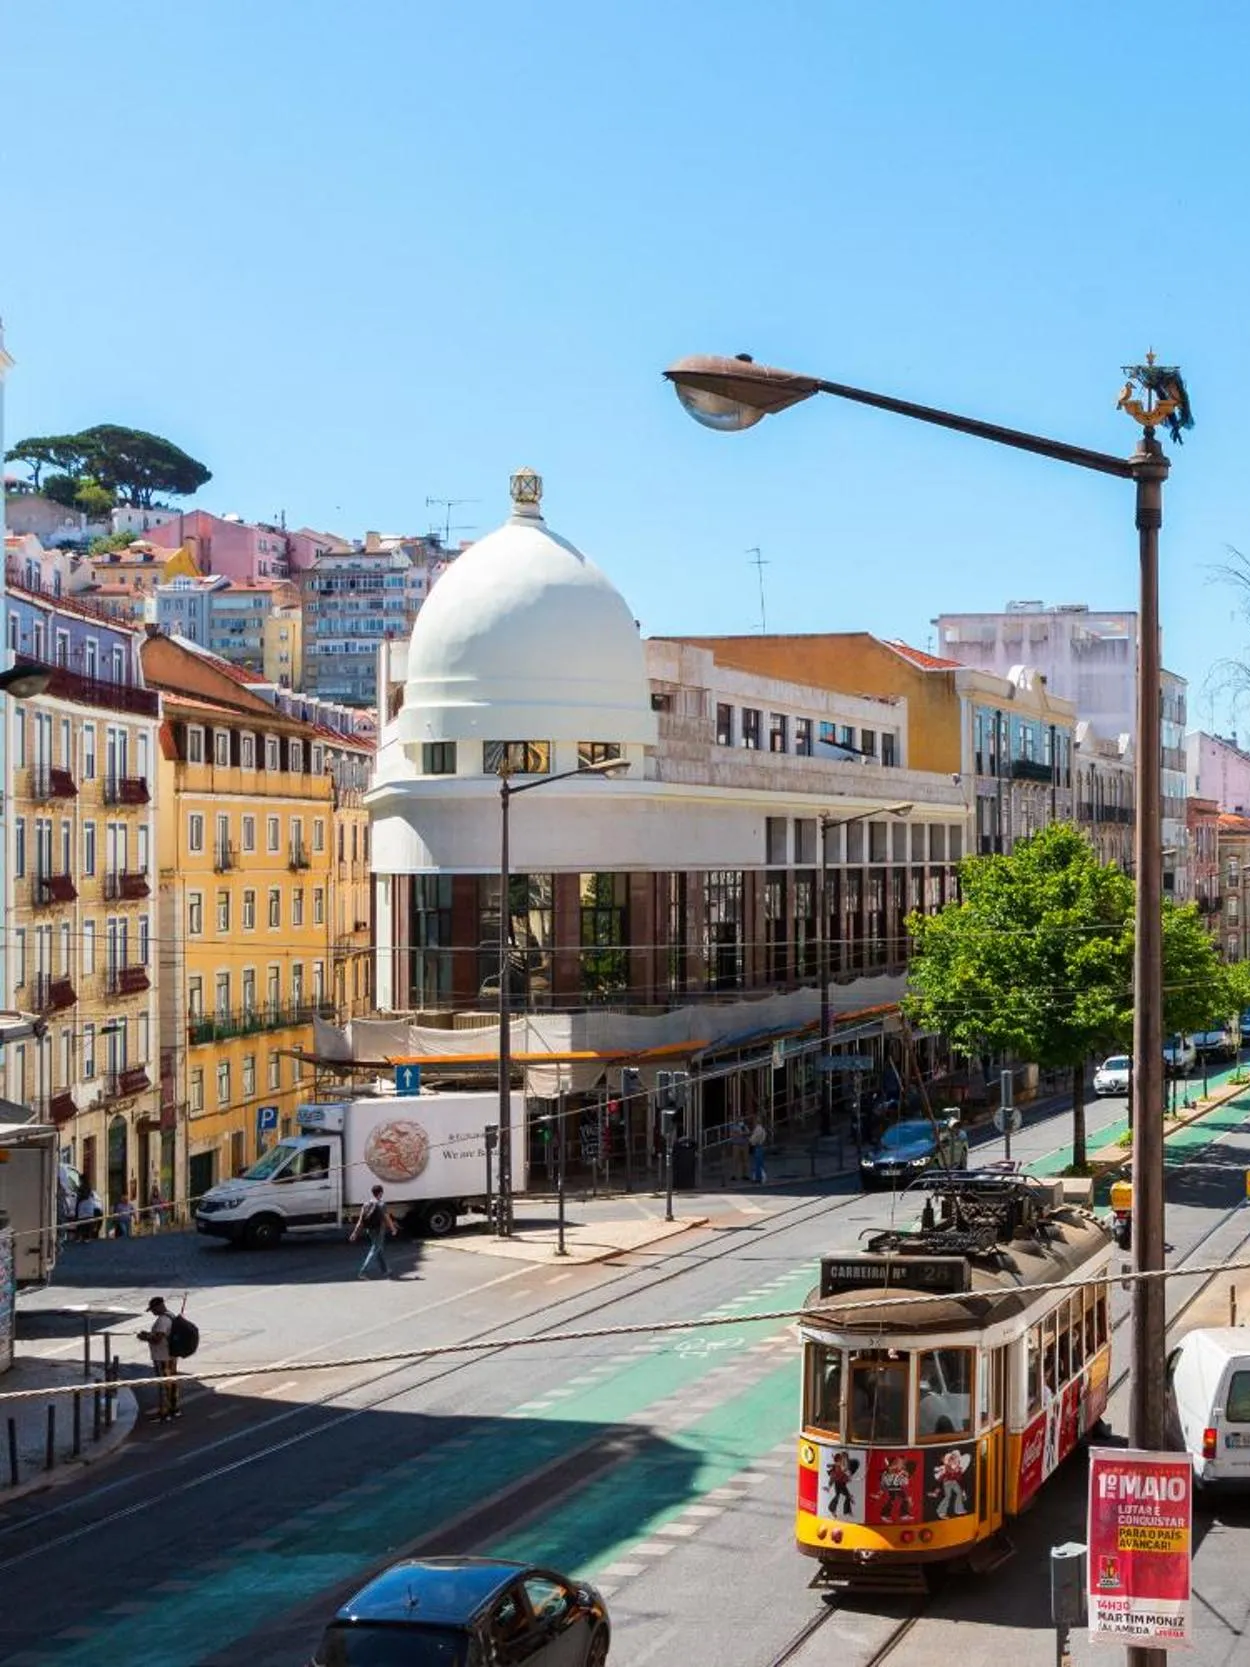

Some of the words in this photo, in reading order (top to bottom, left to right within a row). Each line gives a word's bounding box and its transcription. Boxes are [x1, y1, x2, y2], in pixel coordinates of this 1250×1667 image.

[262, 1108, 275, 1129] P
[830, 1265, 887, 1280] CARREIRA
[1119, 1474, 1186, 1502] MAIO
[1118, 1504, 1152, 1515] LUTAR
[1154, 1506, 1161, 1516] E
[1118, 1515, 1185, 1527] CONQUISTAR
[1119, 1528, 1147, 1538] PARA
[1097, 1611, 1145, 1624] MARTIM
[1146, 1615, 1185, 1627] MONIZ
